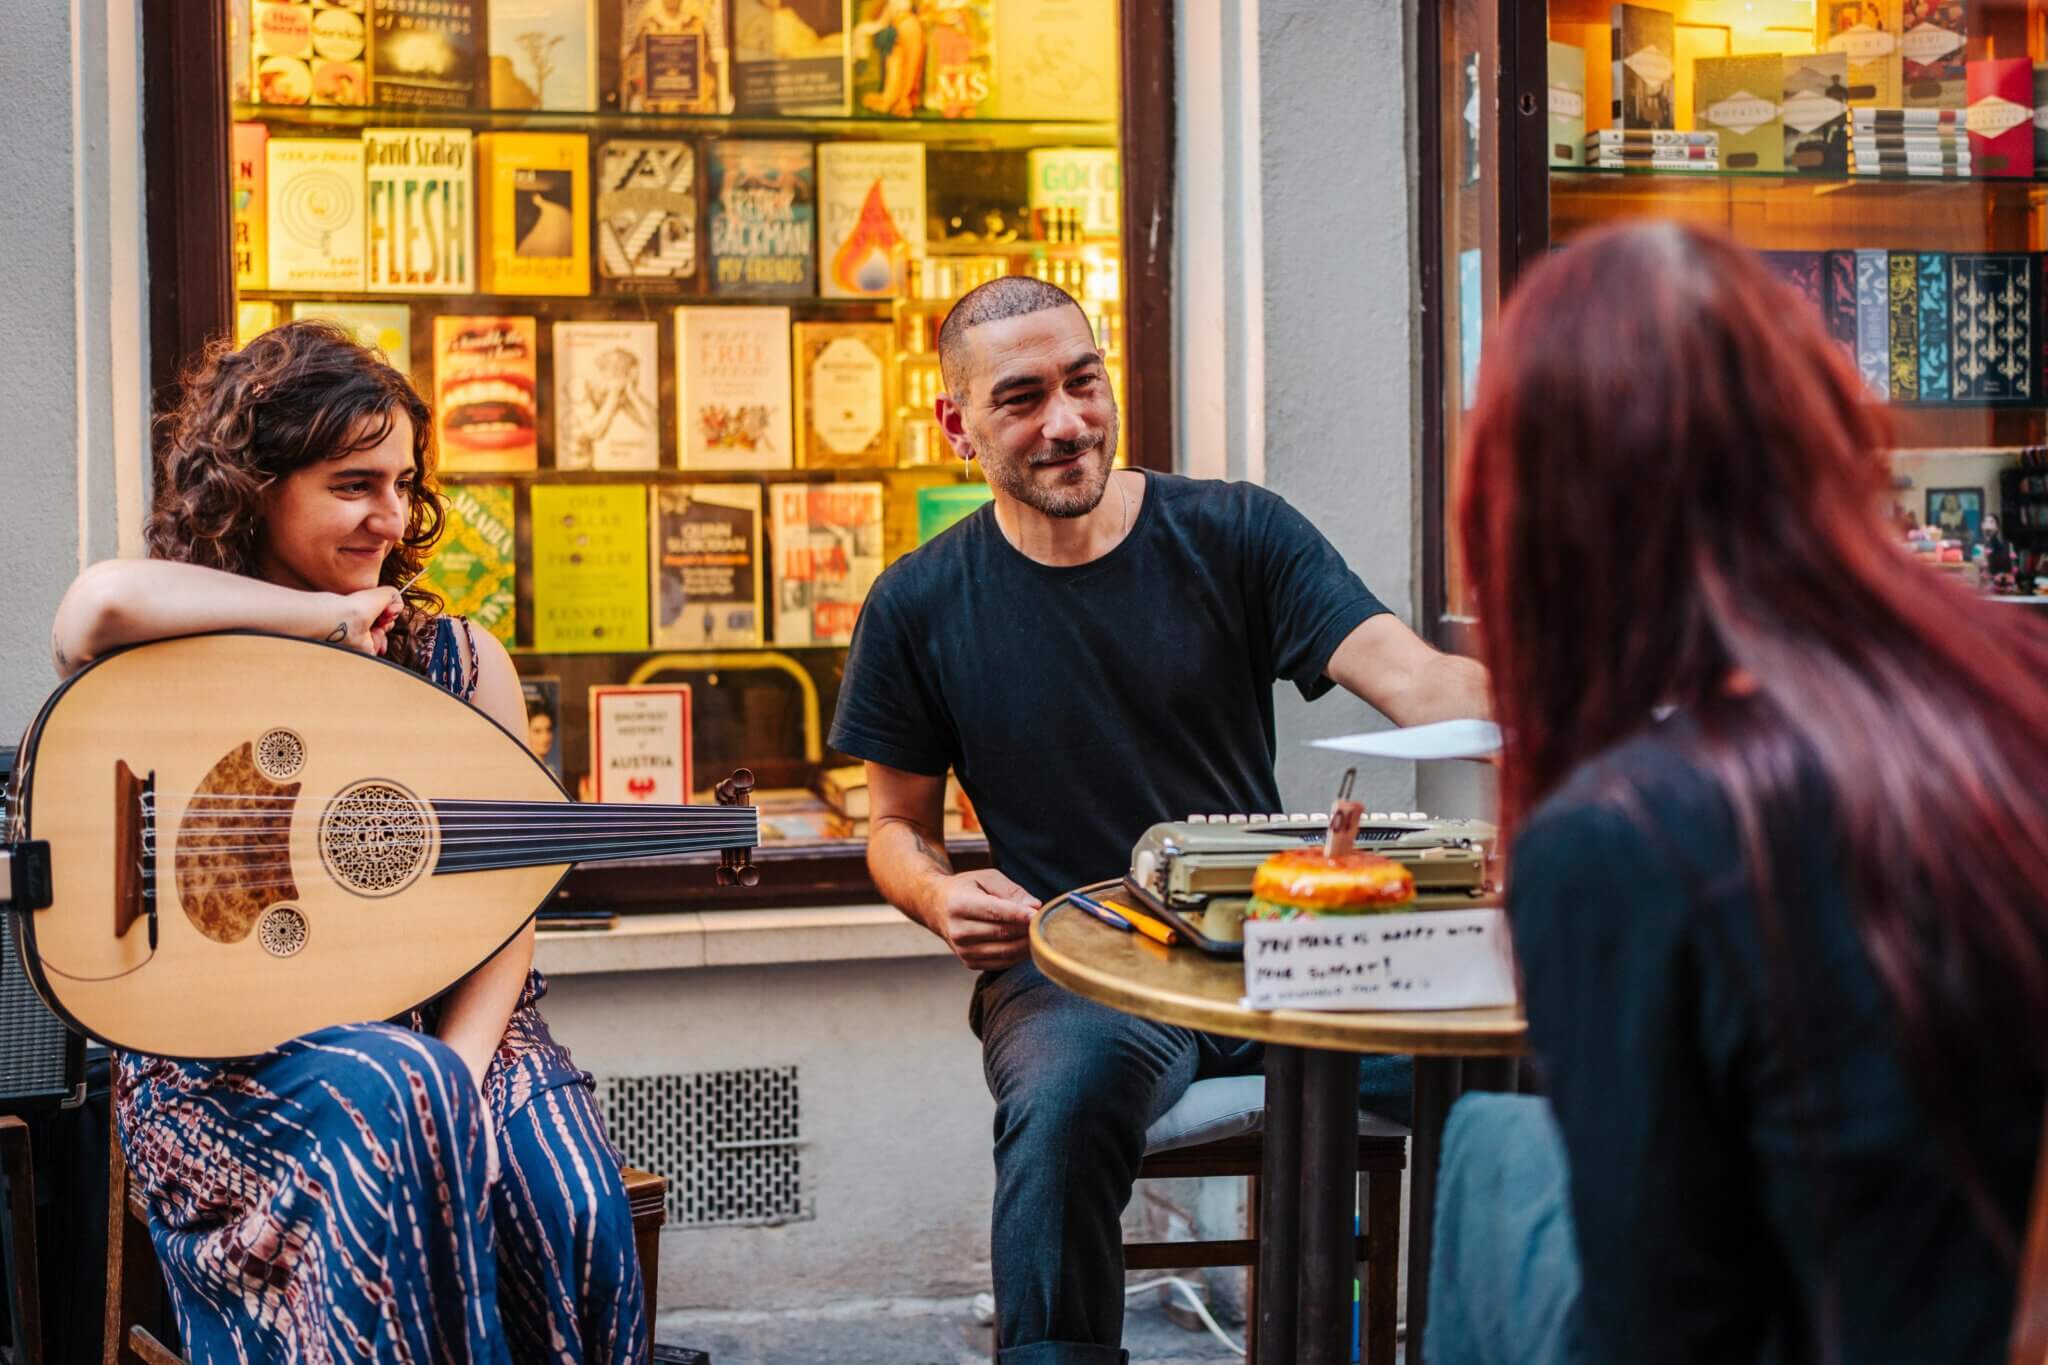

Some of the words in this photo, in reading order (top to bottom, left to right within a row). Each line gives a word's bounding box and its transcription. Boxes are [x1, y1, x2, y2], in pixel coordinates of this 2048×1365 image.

[367, 136, 411, 167] David
[416, 136, 465, 170] Szalay
[371, 180, 465, 283] FLESH
[611, 756, 674, 769] AUSTRIA
[1258, 937, 1291, 957] YOU
[1298, 933, 1344, 949] MAKE
[1382, 926, 1435, 942] HAPPY
